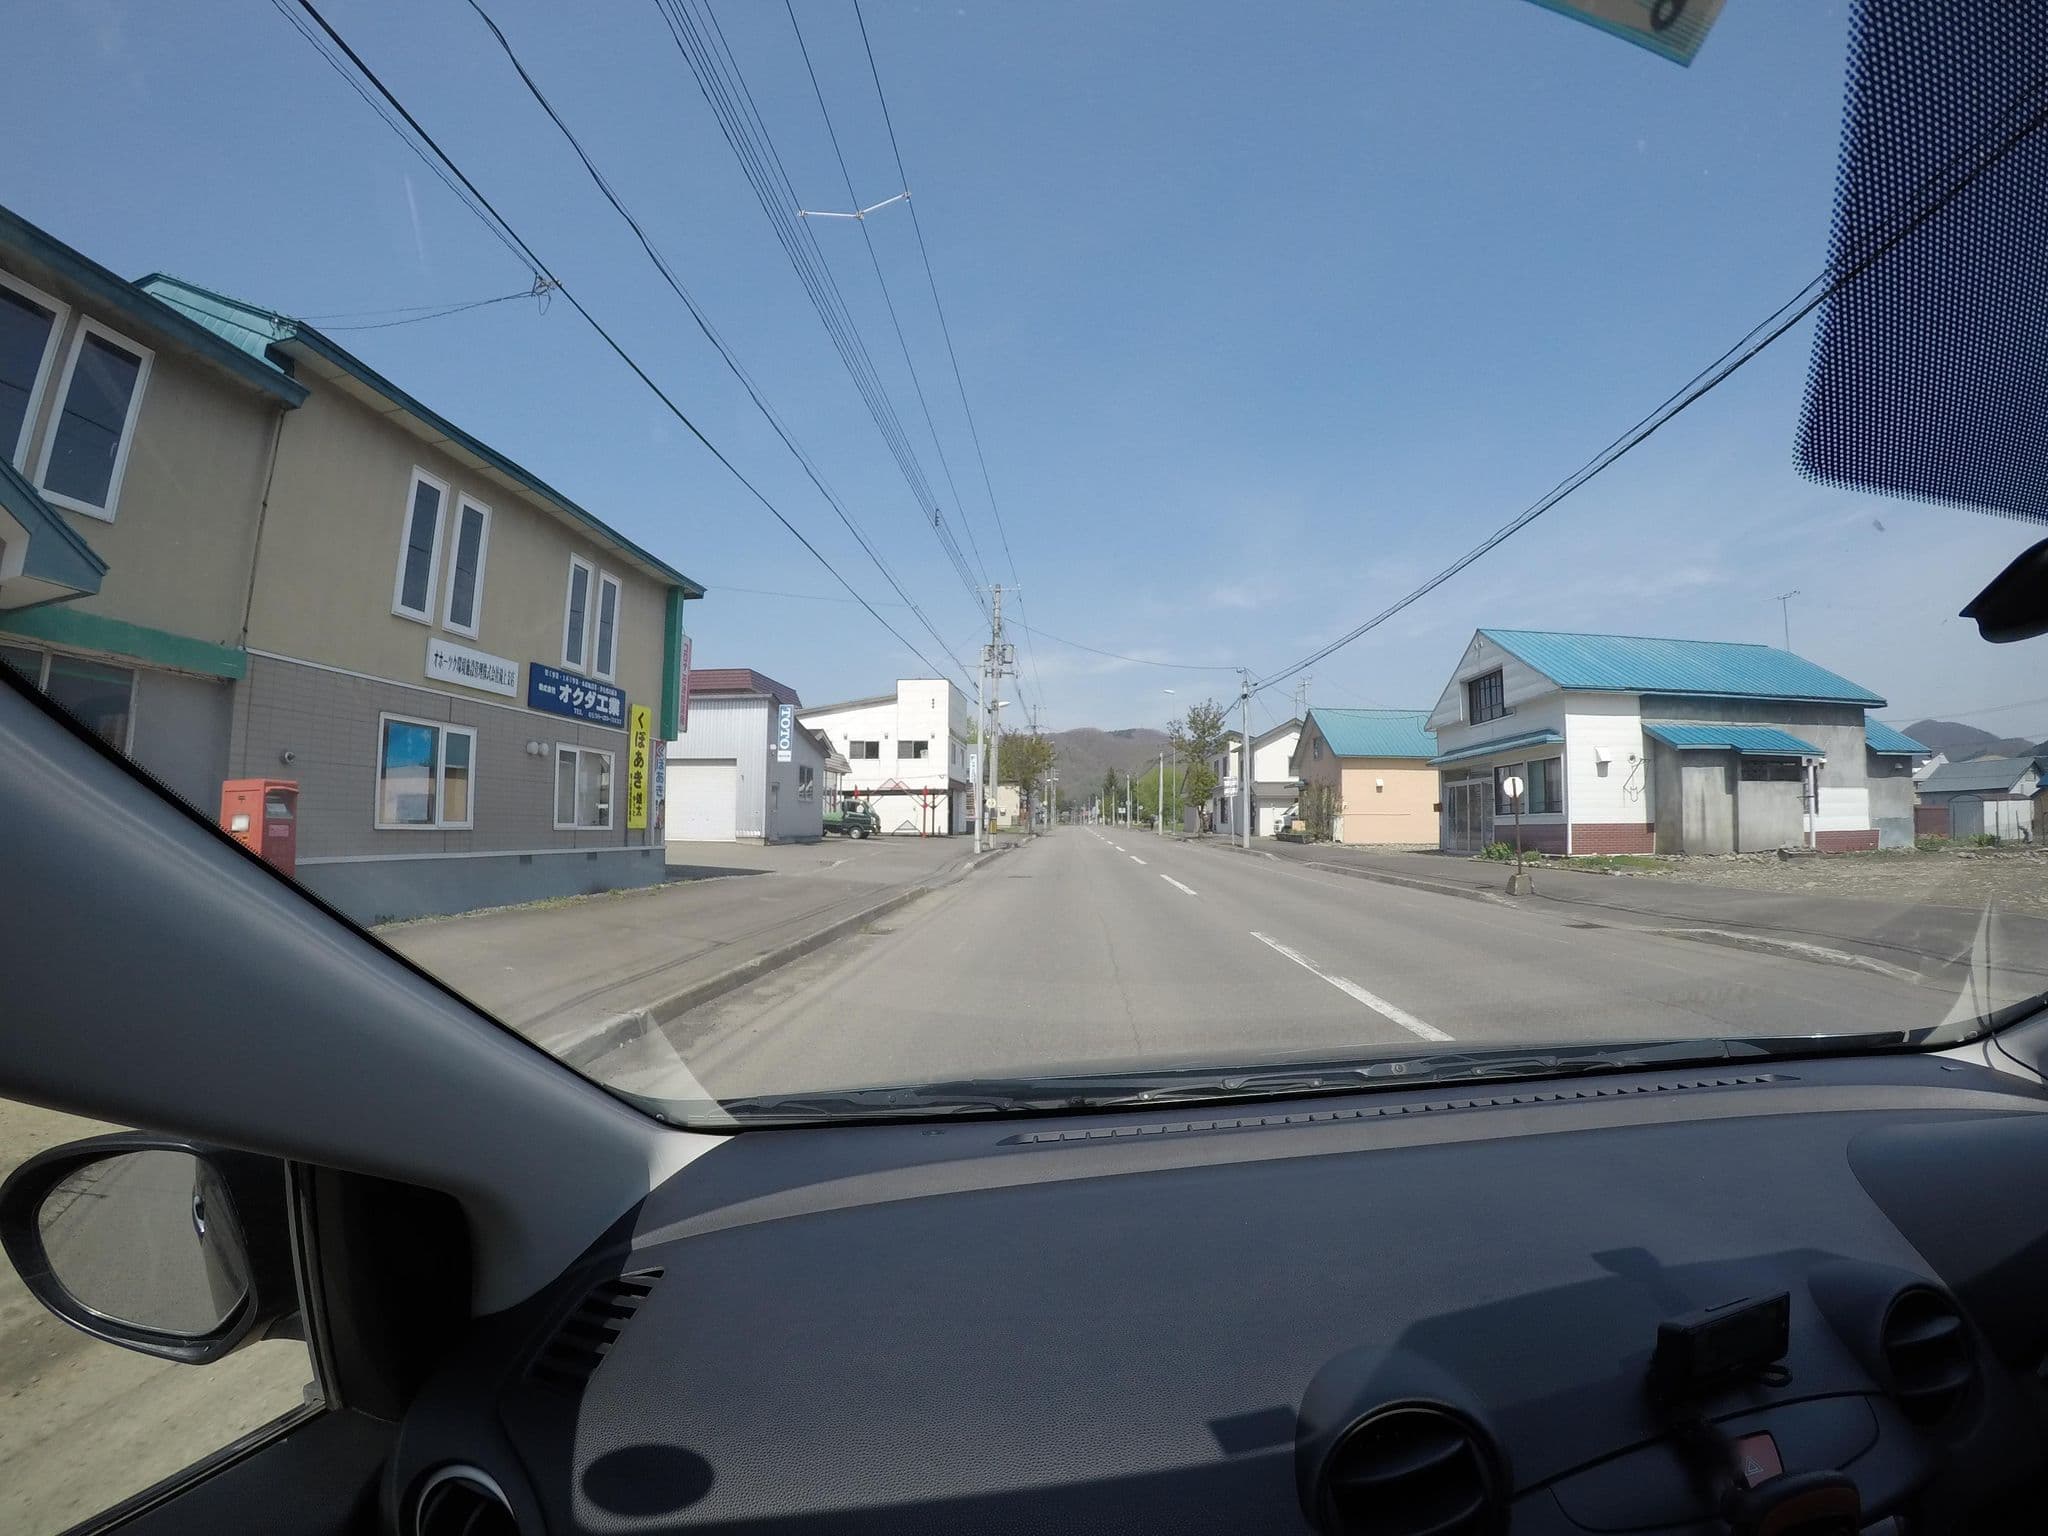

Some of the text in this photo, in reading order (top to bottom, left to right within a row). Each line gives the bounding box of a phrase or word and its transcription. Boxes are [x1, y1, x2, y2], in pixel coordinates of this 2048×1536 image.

[559, 684, 620, 716] オクダ工業
[780, 706, 791, 750] TOTO
